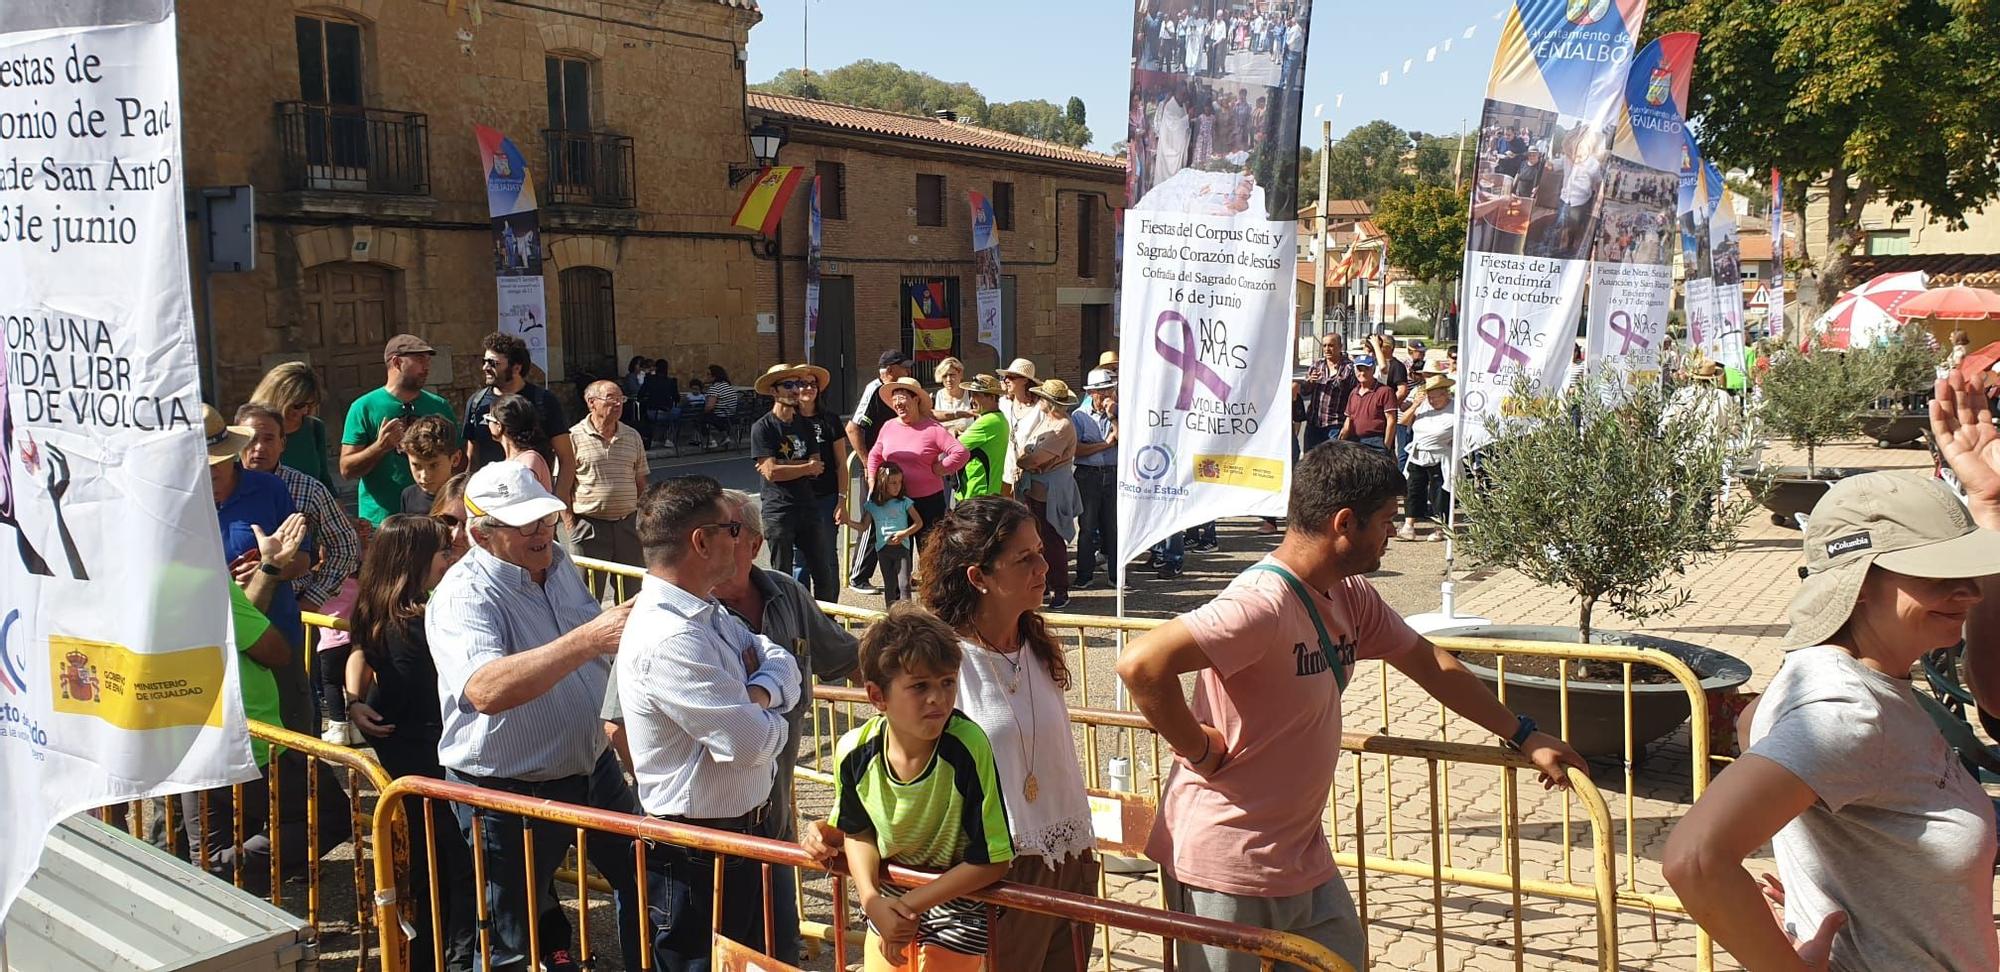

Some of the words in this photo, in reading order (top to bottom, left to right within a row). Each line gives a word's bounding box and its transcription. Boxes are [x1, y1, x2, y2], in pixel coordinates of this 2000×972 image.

[1615, 31, 1631, 44] de
[65, 43, 103, 84] de
[67, 98, 107, 138] de
[41, 156, 97, 191] San
[51, 204, 136, 252] junio
[1141, 220, 1175, 237] Fiestas
[1176, 225, 1193, 238] del
[1195, 224, 1243, 243] Corpus
[1272, 234, 1283, 249] y
[1136, 242, 1177, 261] Sagrado
[1180, 246, 1234, 264] Corazón
[1237, 251, 1249, 266] de
[1249, 253, 1280, 269] Jesús
[1480, 254, 1525, 272] Fiestas
[1529, 260, 1545, 273] de
[1549, 260, 1561, 274] la
[1178, 271, 1193, 282] del
[1194, 272, 1236, 287] Sagrado
[1238, 276, 1276, 291] Corazón
[1489, 271, 1552, 289] Vendimia
[1169, 287, 1183, 302] 16
[1188, 288, 1205, 304] de
[1207, 290, 1241, 309] junio
[1475, 285, 1489, 298] 13
[1493, 287, 1508, 300] de
[1509, 318, 1530, 334] NO
[1633, 313, 1648, 325] NO
[44, 318, 114, 354] UNA
[1200, 317, 1227, 345] NO
[1469, 371, 1485, 383] DE
[25, 389, 62, 423] DE
[1191, 397, 1256, 416] VIOLENCIA
[1148, 410, 1173, 427] DE
[1119, 481, 1142, 494] Pacto
[1154, 485, 1189, 496] Estado
[1833, 537, 1869, 551] Columbia
[133, 679, 187, 691] MINISTERIO
[136, 692, 149, 701] DE
[149, 686, 204, 701] IGUALDAD
